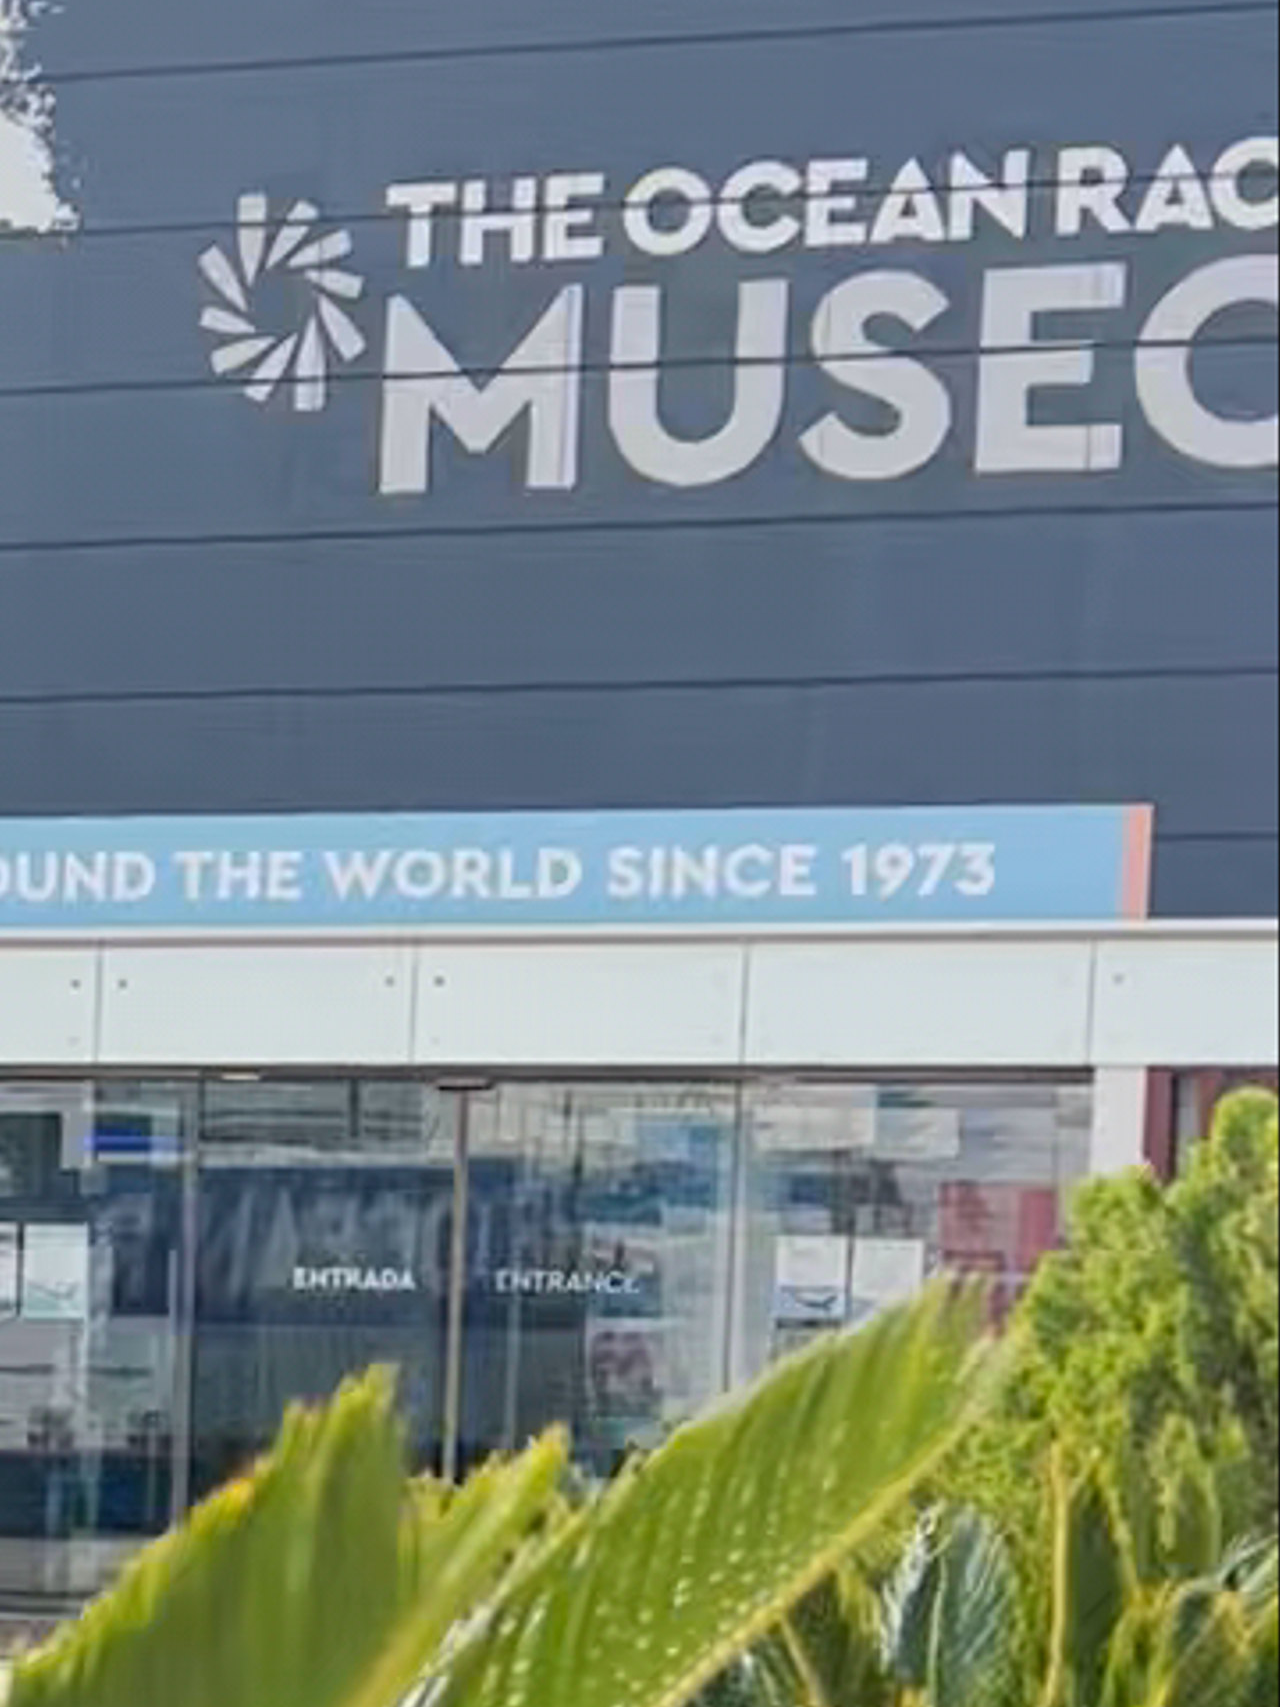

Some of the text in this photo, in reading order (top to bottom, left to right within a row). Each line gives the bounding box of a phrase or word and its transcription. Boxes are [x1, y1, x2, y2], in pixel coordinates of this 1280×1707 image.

[385, 172, 606, 268] THE
[622, 150, 1030, 257] OCEAN
[173, 850, 302, 901] THE
[324, 846, 583, 899] WORLD
[606, 843, 819, 898] SINCE
[841, 841, 997, 897] 1973
[293, 1267, 640, 1294] ENTRADA ENTRANCE
